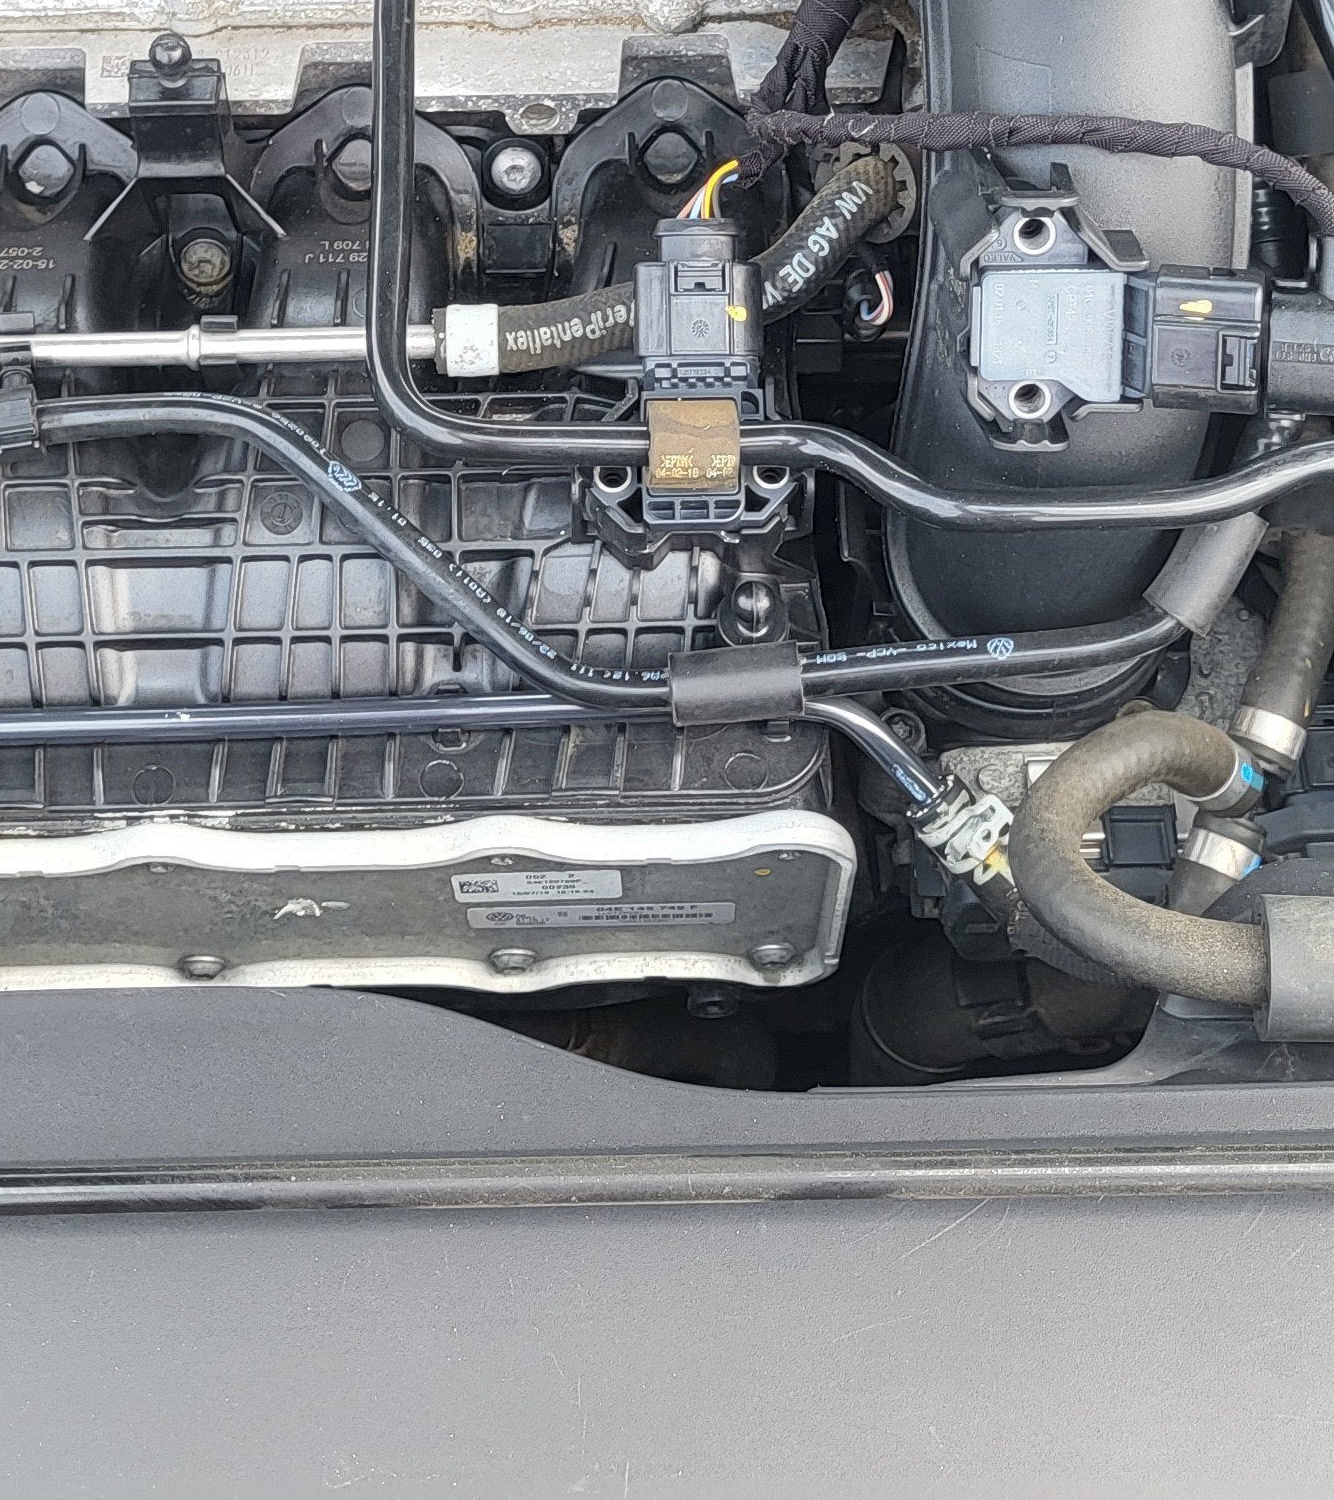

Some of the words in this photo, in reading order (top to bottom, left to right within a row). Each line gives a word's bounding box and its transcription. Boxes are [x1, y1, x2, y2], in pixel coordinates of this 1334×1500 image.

[811, 216, 844, 260] AG
[318, 240, 329, 249] L
[333, 239, 361, 249] 709
[304, 252, 314, 263] J
[317, 251, 346, 262] 711
[775, 255, 815, 295] DE
[913, 634, 979, 658] Mexico
